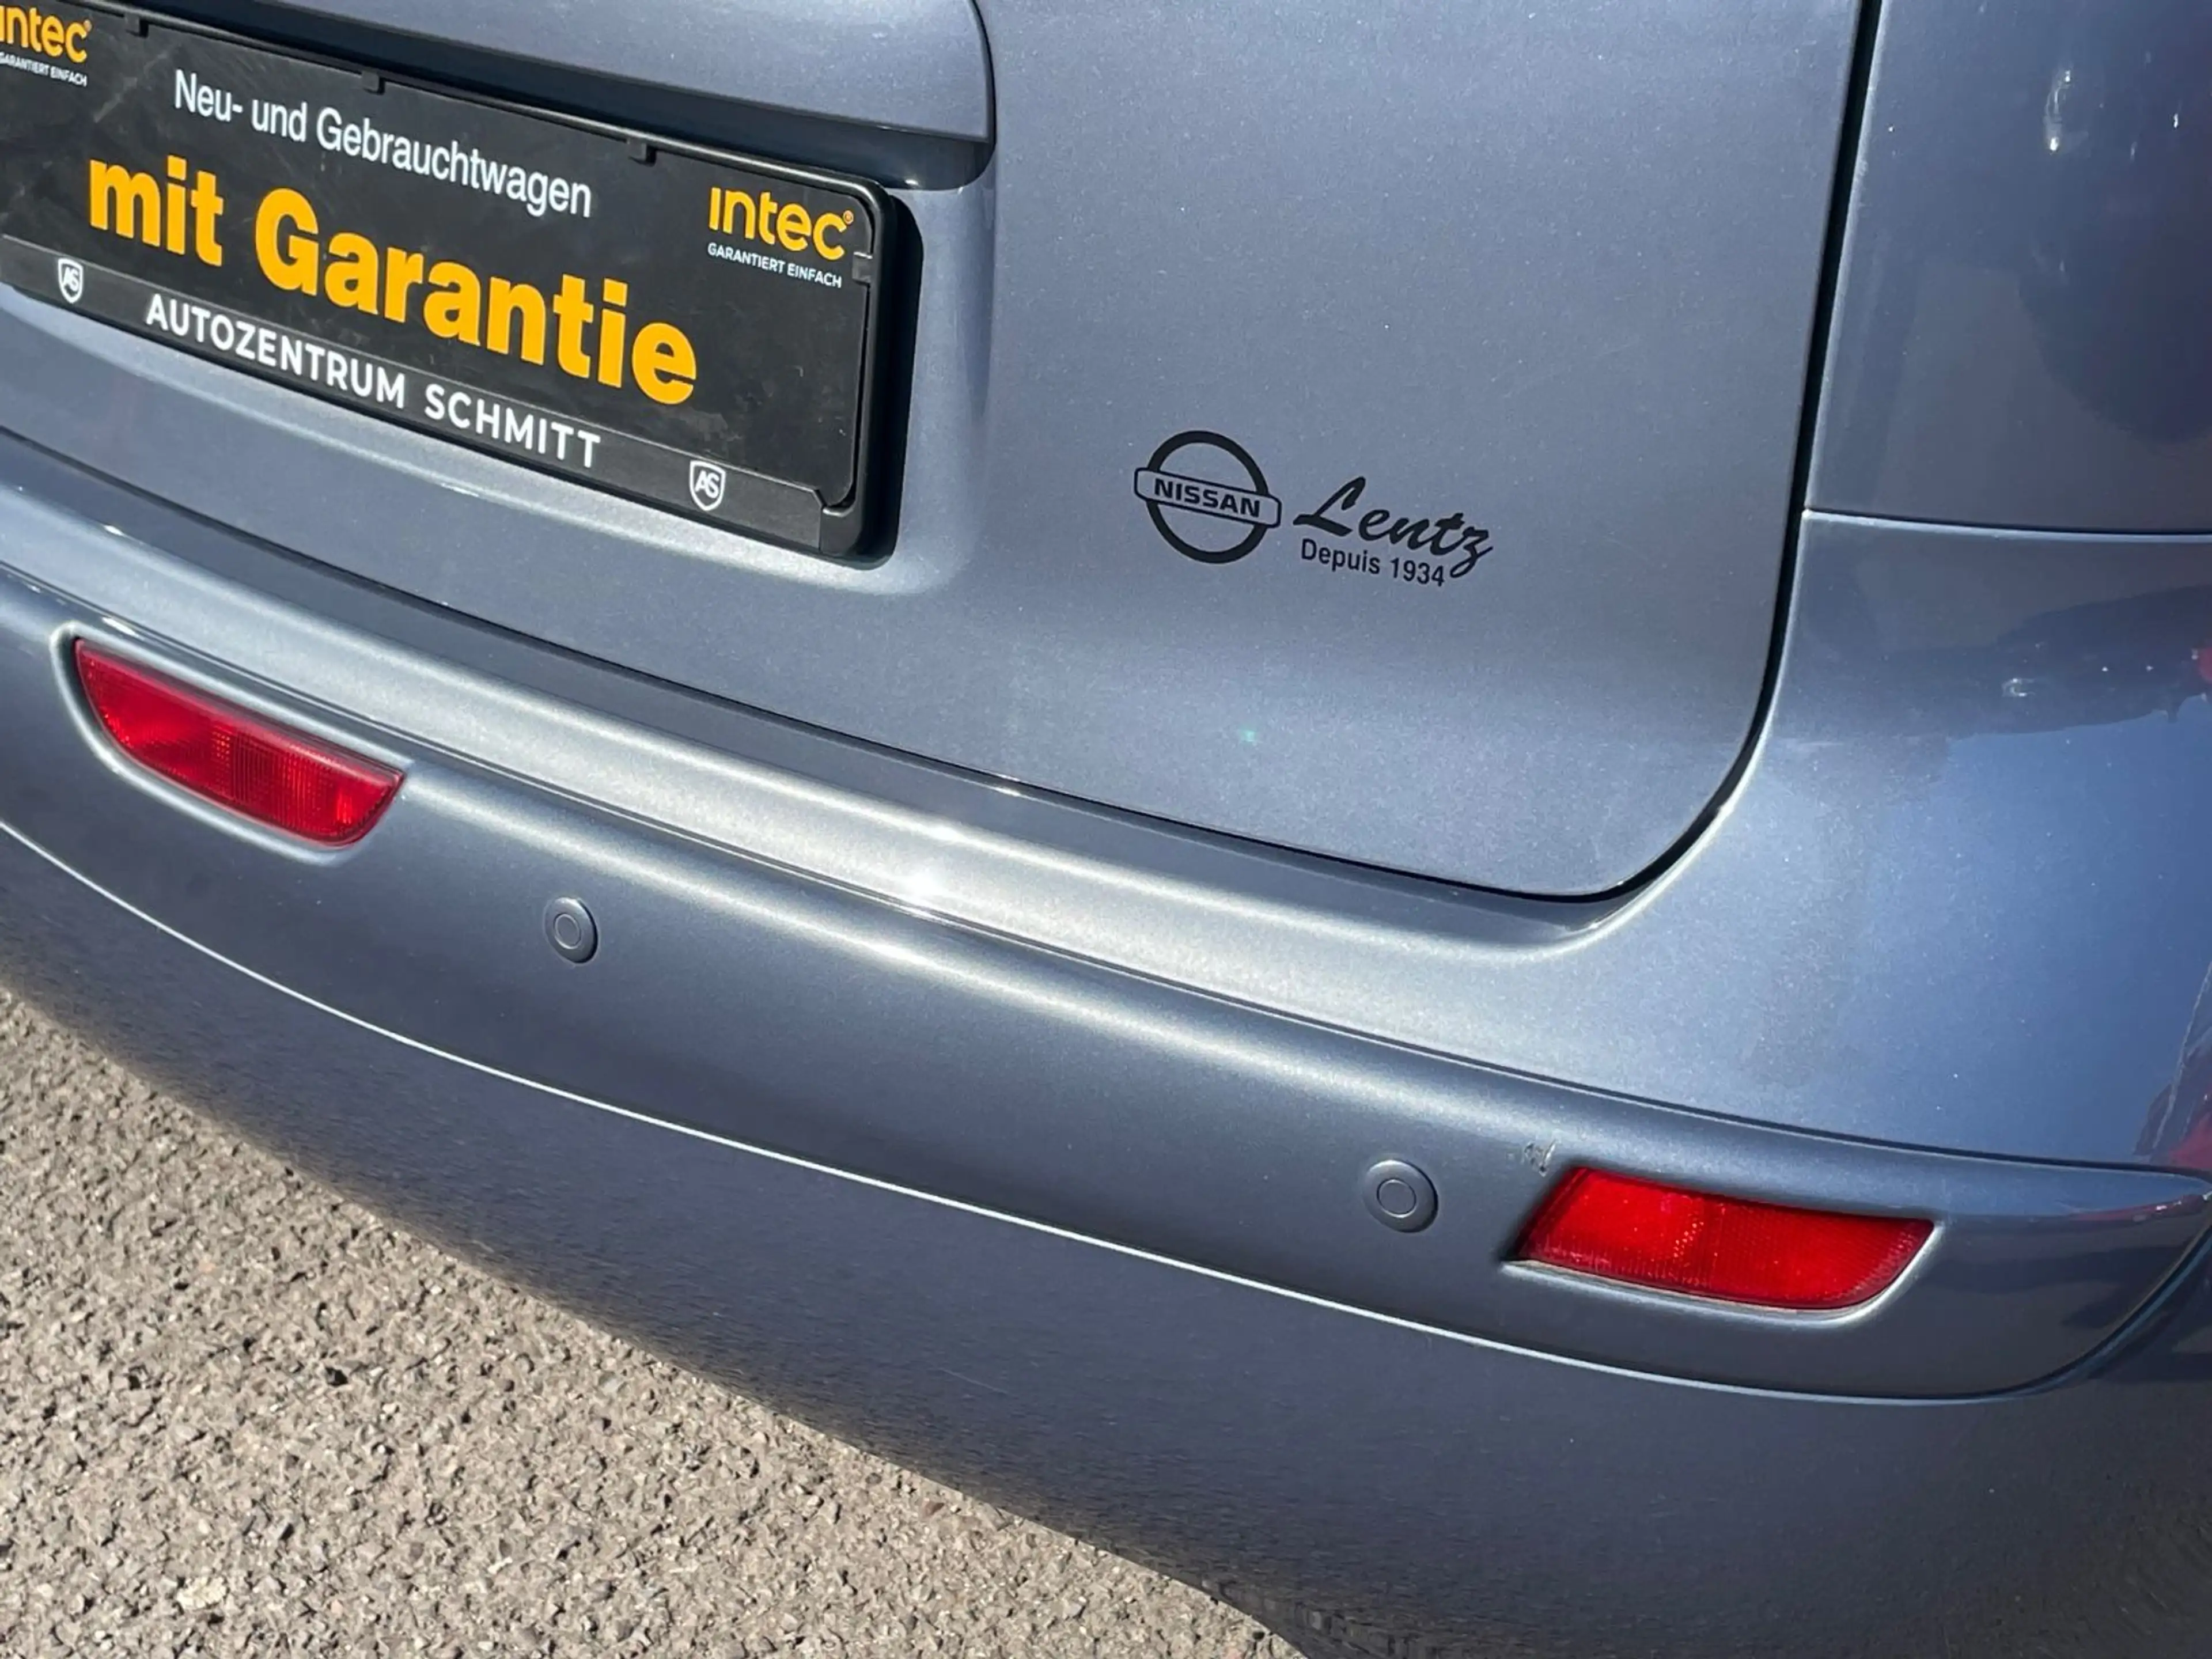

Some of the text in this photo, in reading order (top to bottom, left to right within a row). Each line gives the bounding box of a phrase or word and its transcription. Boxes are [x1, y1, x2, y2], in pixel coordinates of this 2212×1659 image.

[50, 66, 88, 87] EINFACH
[175, 69, 592, 218] Neu- und Gebrauchtwagen
[89, 154, 697, 406] mit Garantie
[707, 242, 842, 288] GARANTIERT EINFACH
[145, 293, 601, 468] AUTOZENTRUM SCHMITT
[1154, 478, 1260, 518] NISSAN
[1293, 476, 1494, 578] Lentz
[1301, 538, 1445, 586] Depuis 1934
